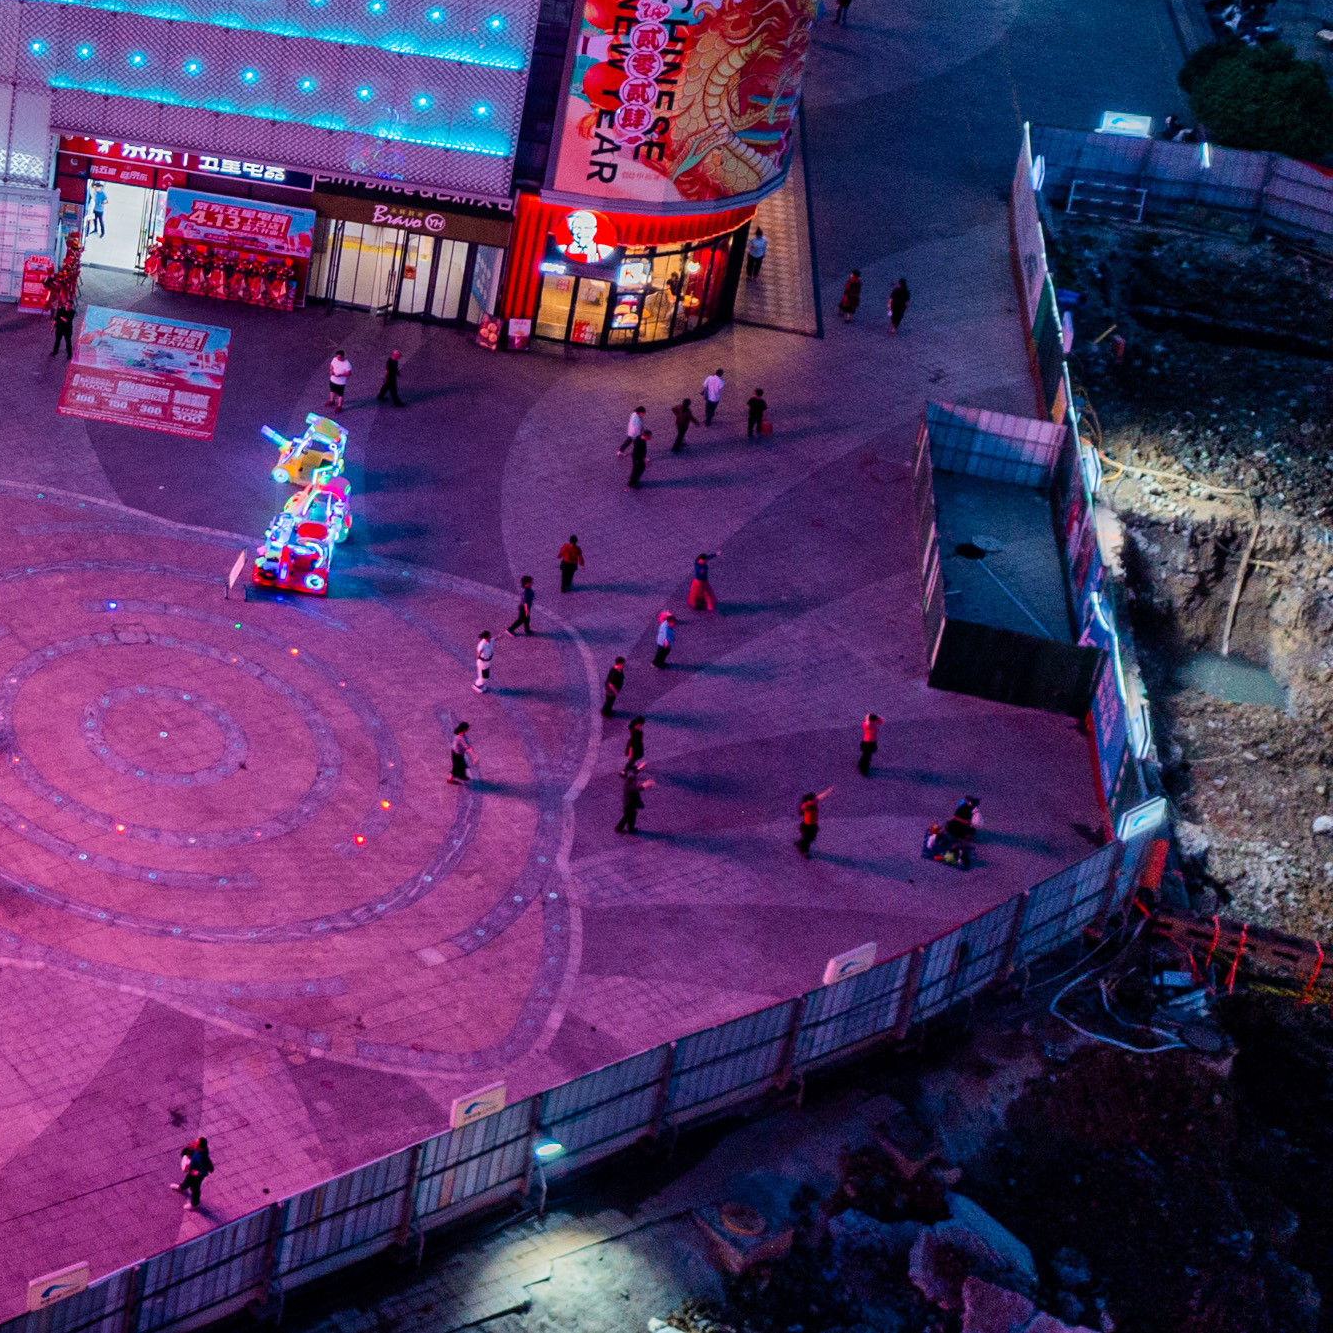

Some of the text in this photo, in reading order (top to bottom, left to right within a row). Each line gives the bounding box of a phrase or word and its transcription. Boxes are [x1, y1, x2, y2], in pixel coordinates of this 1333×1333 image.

[586, 89, 622, 184] YEAR
[189, 210, 241, 230] 4.13
[372, 205, 422, 229] Bravo
[103, 325, 158, 343] 4.13
